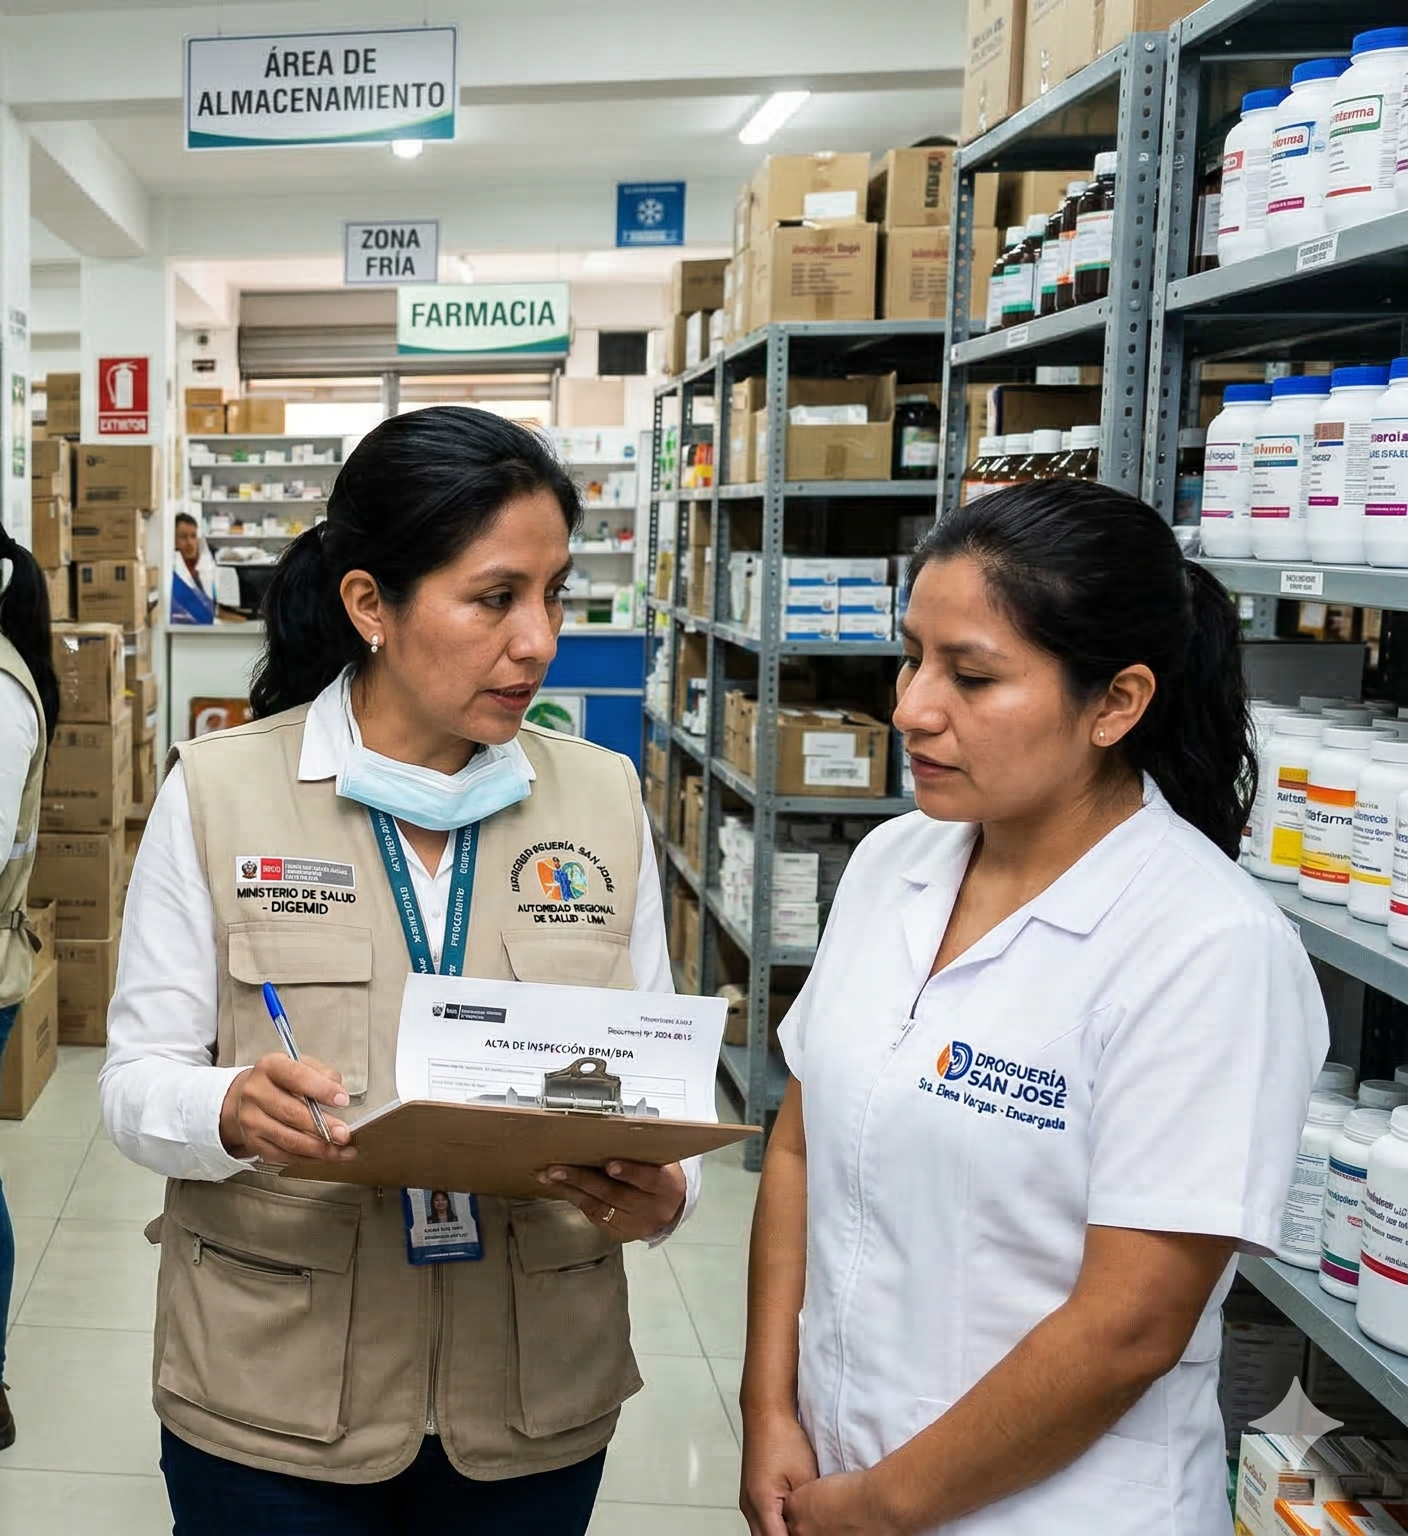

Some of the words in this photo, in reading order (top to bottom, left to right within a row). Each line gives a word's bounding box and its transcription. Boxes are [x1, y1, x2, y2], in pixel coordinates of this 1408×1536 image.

[265, 46, 333, 78] ÁREA
[343, 48, 377, 75] DE
[198, 81, 445, 116] ALMACENAMIENTO
[361, 228, 421, 250] ZONA
[365, 250, 416, 277] FRÍA
[411, 300, 555, 328] FARMACIA
[237, 887, 298, 899] MINISTERIO
[302, 889, 316, 900] DE
[320, 890, 356, 903] SALUD
[271, 901, 328, 915] DIGEMID
[533, 914, 546, 923] DE
[485, 1039, 510, 1049] ACTA
[512, 1041, 526, 1050] DE
[588, 1047, 634, 1059] BPM/BPA
[975, 1053, 1067, 1090] DROGUERÍA
[968, 1070, 1008, 1095] SAN
[1011, 1083, 1067, 1109] JOSÉ
[1006, 1105, 1066, 1131] Encargada
